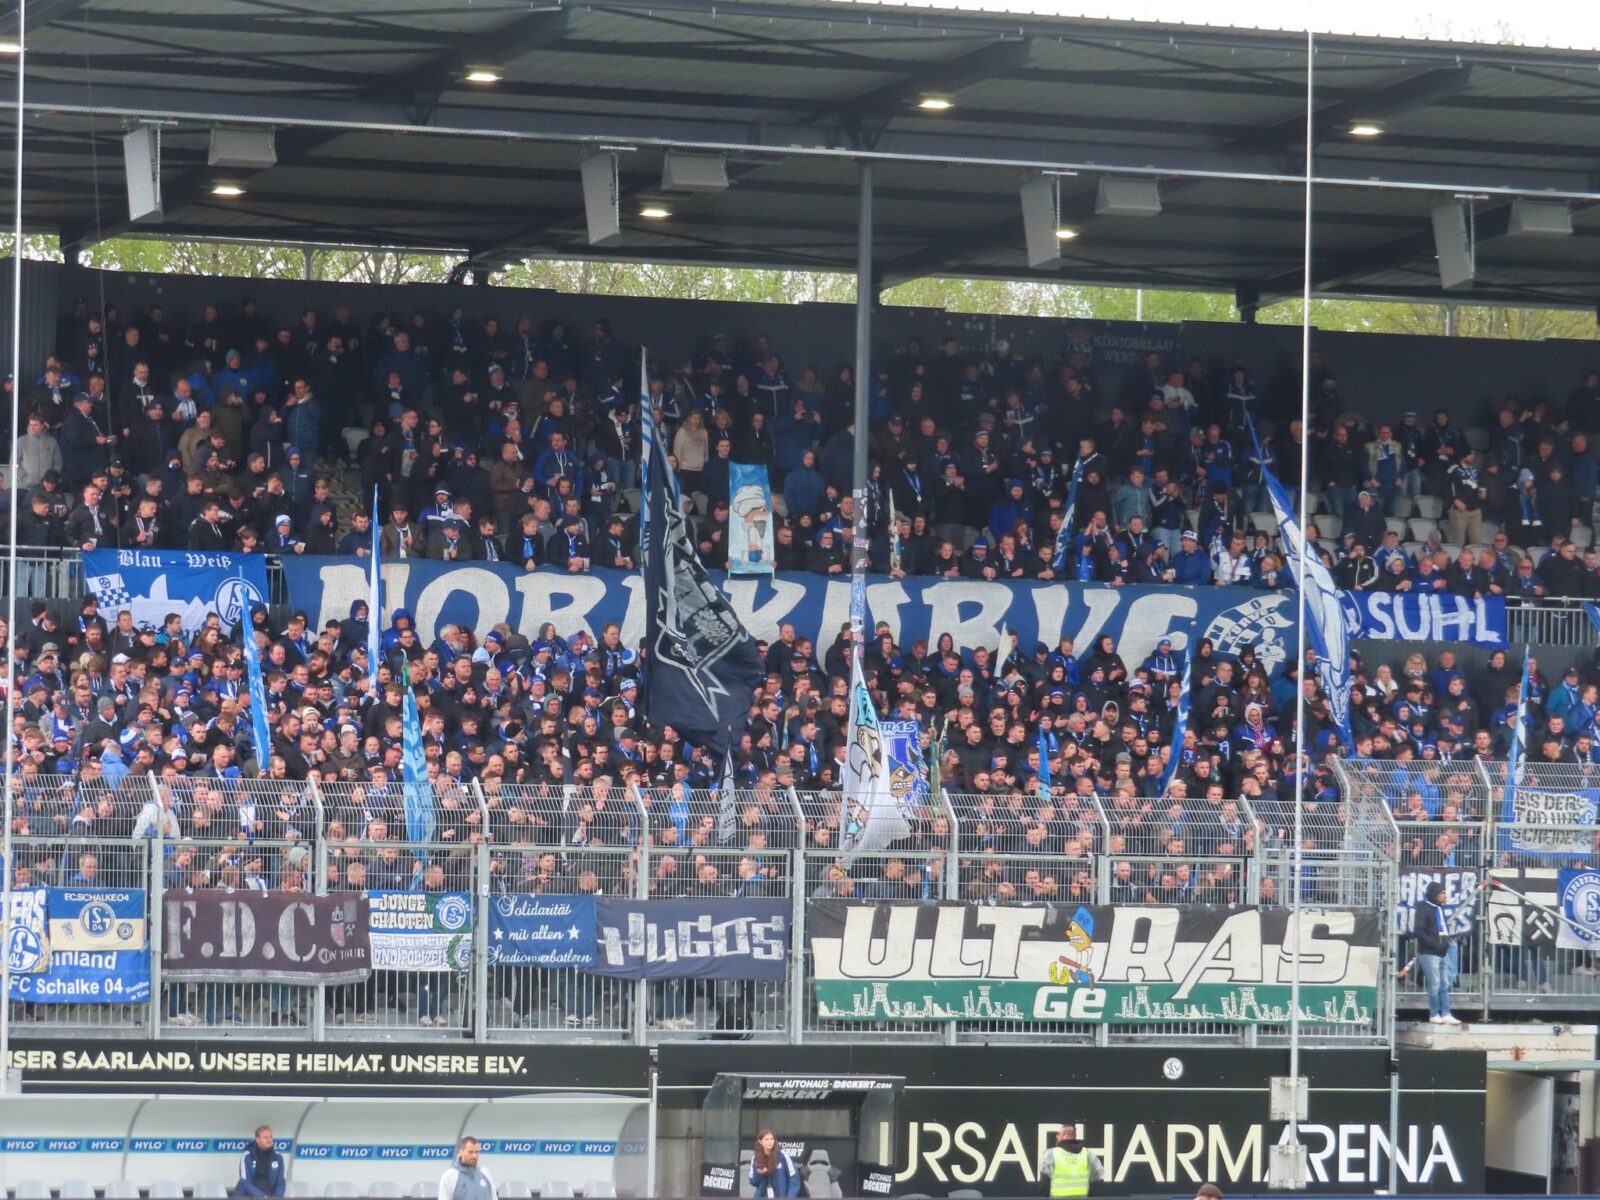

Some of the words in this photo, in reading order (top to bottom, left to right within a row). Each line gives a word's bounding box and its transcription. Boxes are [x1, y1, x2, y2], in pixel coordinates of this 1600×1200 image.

[118, 549, 162, 568] Blau
[186, 553, 232, 569] Weiß
[1367, 591, 1503, 642] SUHL
[379, 894, 426, 911] JUNGE
[497, 895, 571, 917] Solidarität
[370, 912, 434, 929] CHAOTEN
[508, 928, 528, 940] mit
[531, 924, 564, 940] allen
[597, 912, 784, 966] HUGOS
[374, 947, 398, 965] UND
[37, 979, 99, 994] Schalke
[104, 978, 123, 994] 04
[63, 1051, 195, 1071] SAARLAND.
[200, 1053, 290, 1071] UNSERE
[296, 1053, 386, 1073] HEIMAT.
[391, 1055, 479, 1073] UNSERE
[485, 1056, 528, 1074] ELV.
[7, 1140, 35, 1150] HYLO
[49, 1140, 78, 1150] HYLO
[91, 1140, 119, 1150] HYLO
[134, 1140, 163, 1150] HYLO
[176, 1140, 204, 1150] HYLO
[218, 1140, 246, 1150] HYLO
[505, 1143, 532, 1152] HYLO
[545, 1143, 572, 1152] HYLO
[585, 1143, 611, 1152] HYLO
[778, 1141, 805, 1149] TOHAUS
[301, 1147, 328, 1157] HYLO
[341, 1147, 369, 1157] HYLO
[382, 1147, 410, 1157] HYLO
[423, 1147, 450, 1157] HYLO
[711, 1167, 735, 1178] AUTOHAUS
[703, 1175, 734, 1190] DECKERT
